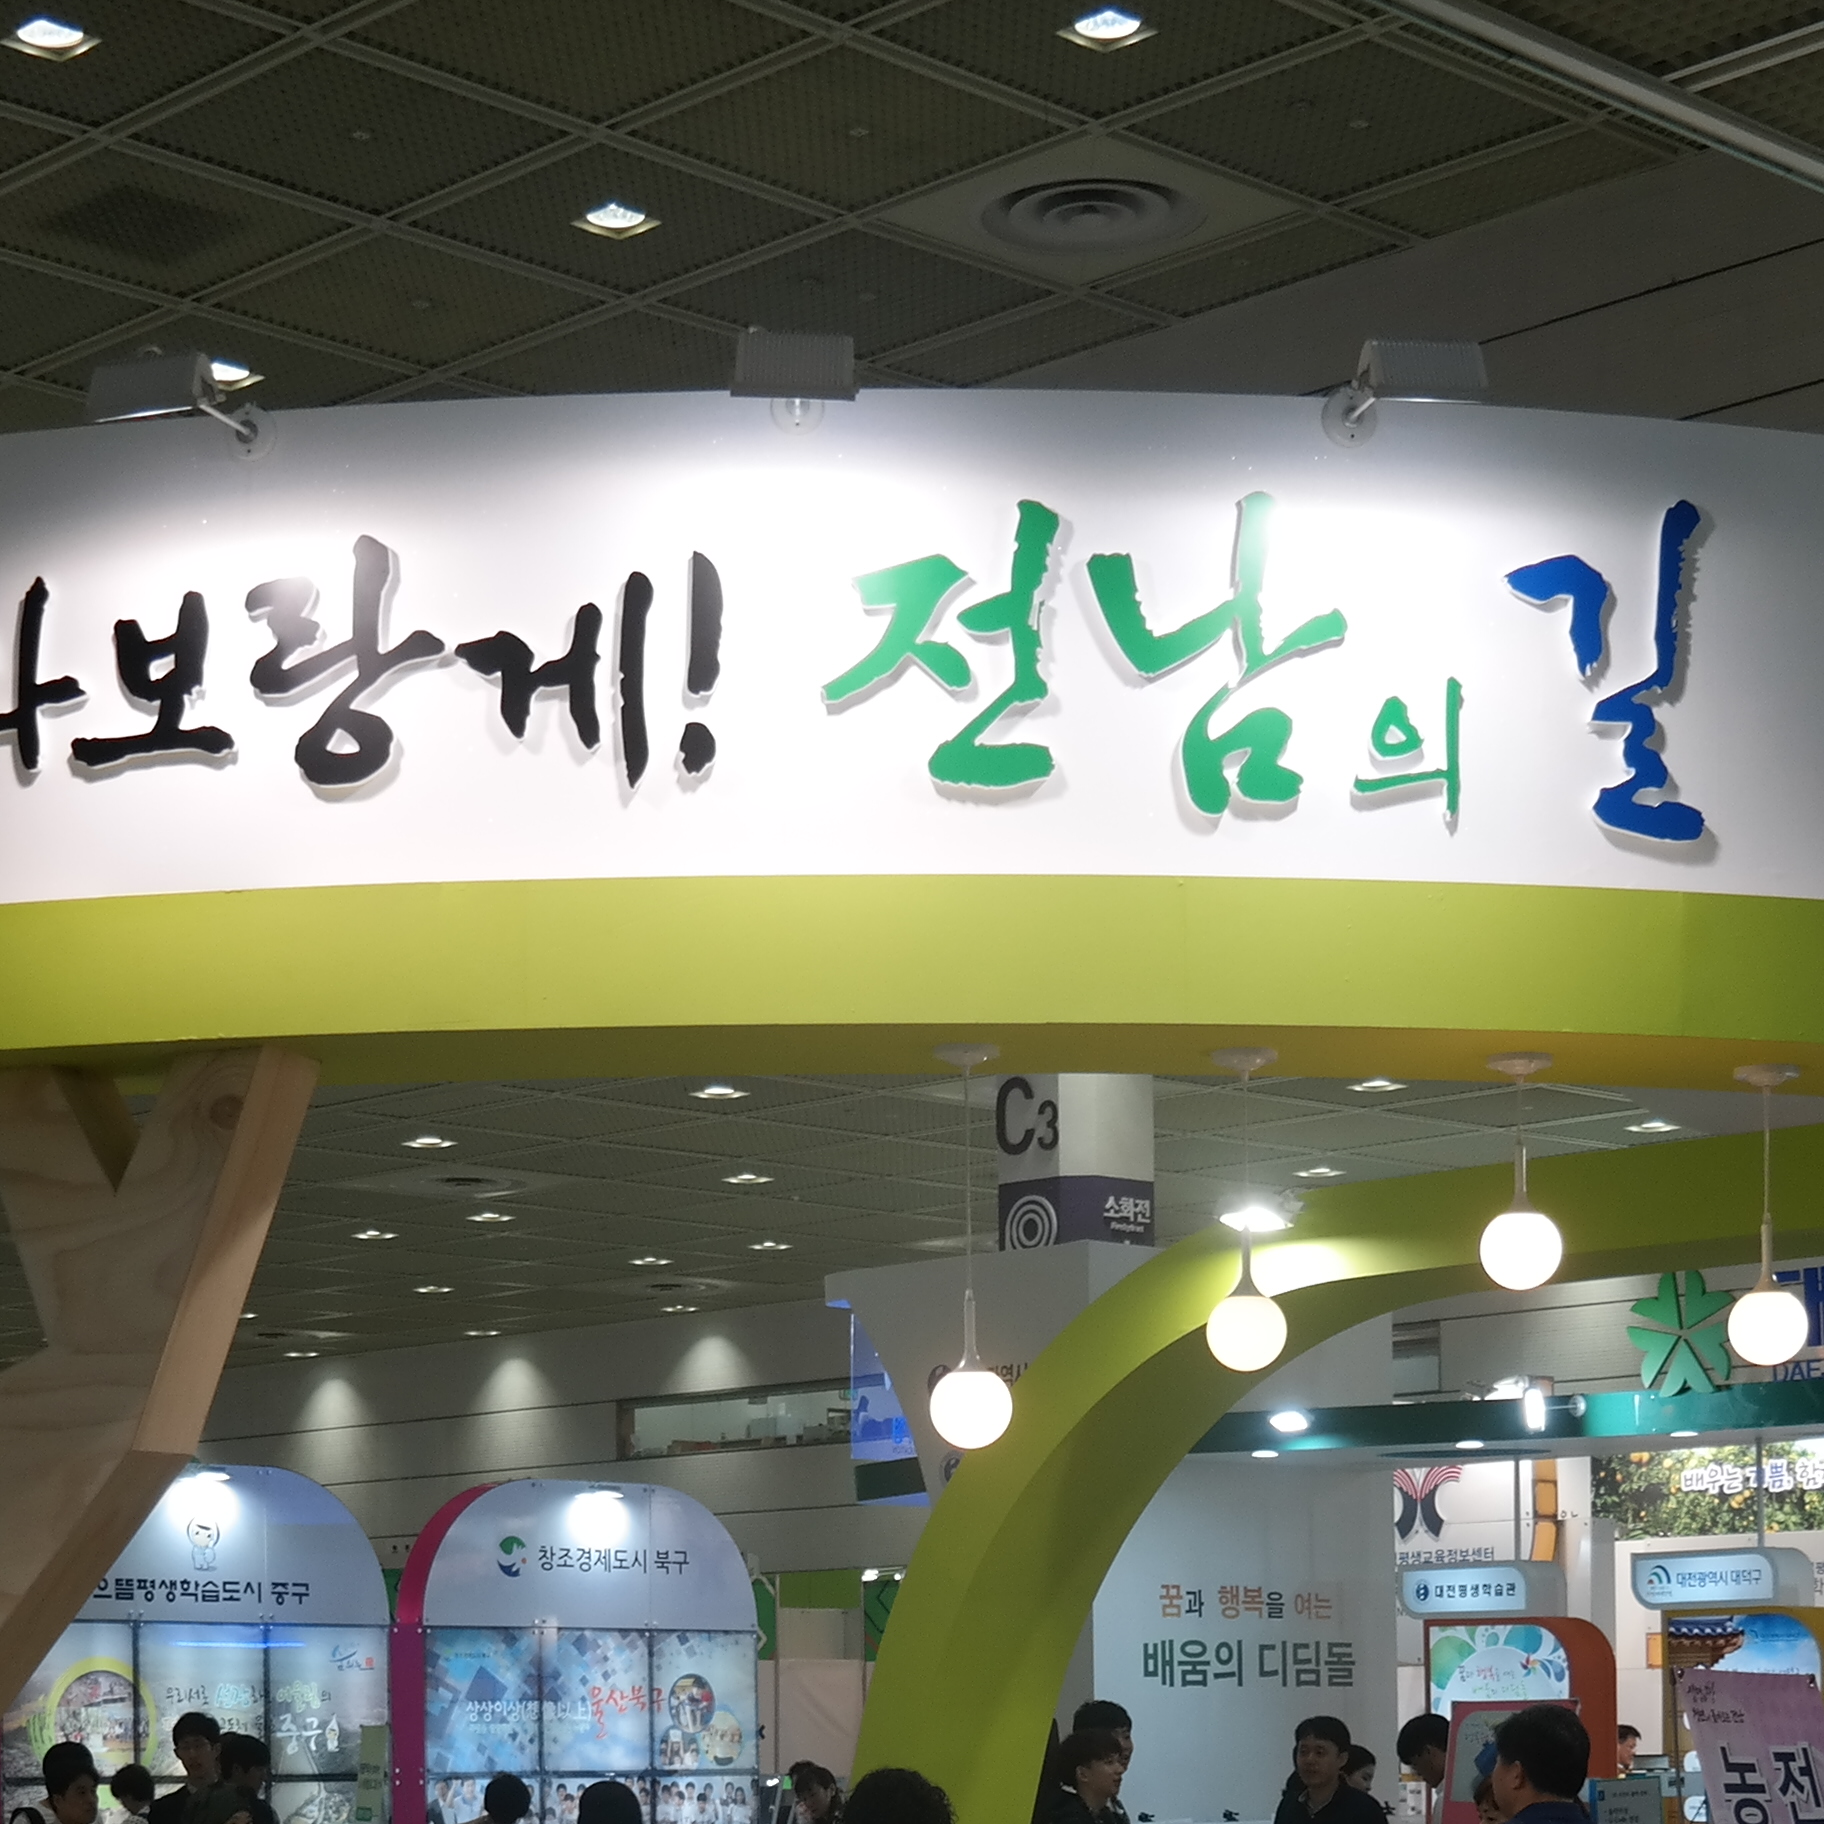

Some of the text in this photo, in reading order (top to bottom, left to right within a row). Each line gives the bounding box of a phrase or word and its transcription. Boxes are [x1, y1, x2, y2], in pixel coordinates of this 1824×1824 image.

[1504, 500, 1706, 840] 길
[994, 1076, 1059, 1156] C3
[1103, 1195, 1151, 1223] 소화전
[1682, 1463, 1744, 1495] 배우는
[537, 1545, 691, 1576] 창조경제도시 북구
[270, 1582, 311, 1606] 중구
[1434, 1582, 1517, 1598] 대전평생학습관
[1676, 1568, 1763, 1588] 대전광역시 대덕구
[1159, 1583, 1333, 1620] 꿈과 행복을 여는
[1142, 1638, 1356, 1688] 배움의 디딤돌
[272, 1712, 324, 1755] 중구
